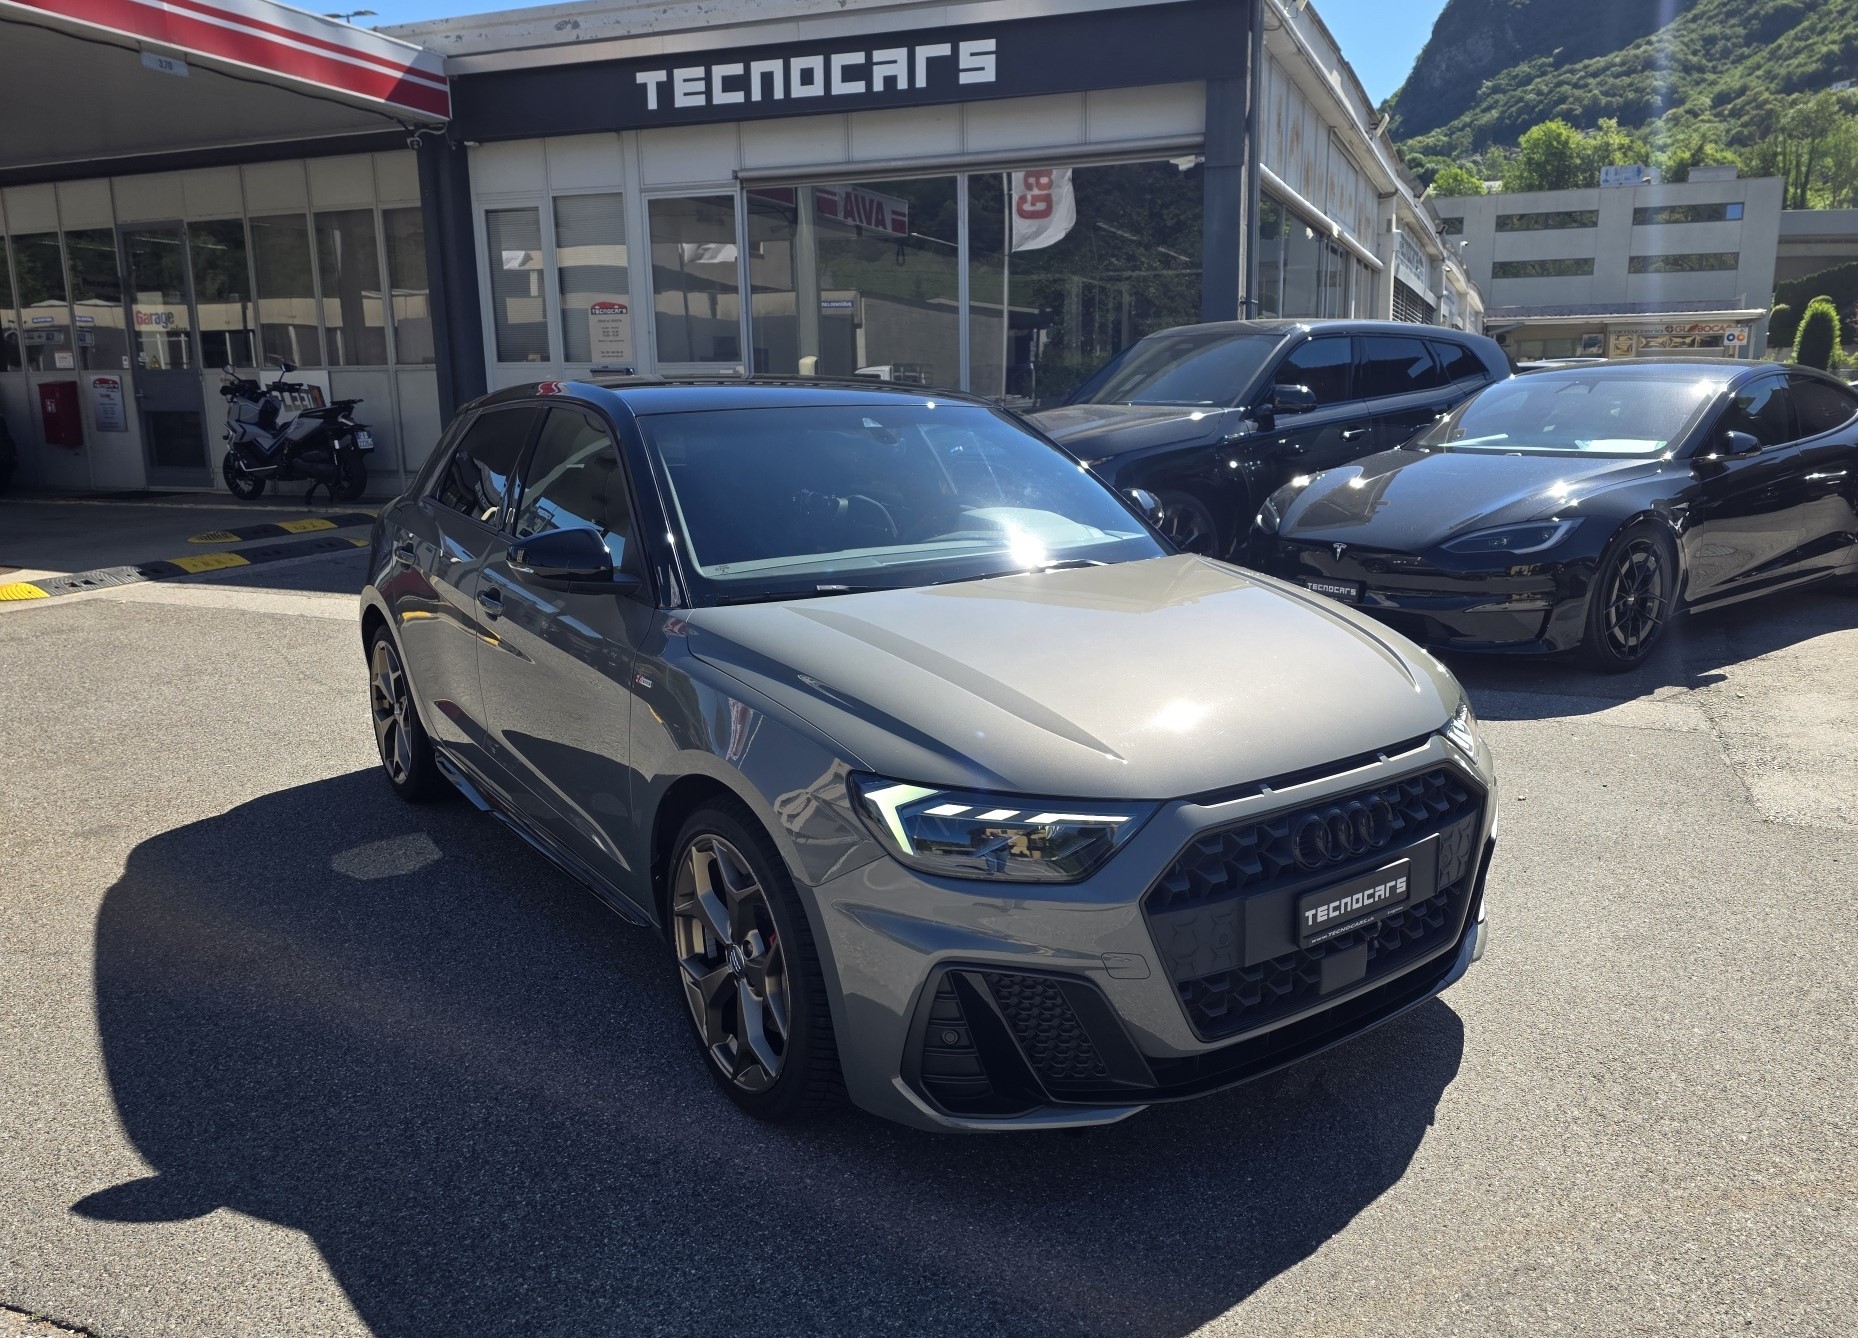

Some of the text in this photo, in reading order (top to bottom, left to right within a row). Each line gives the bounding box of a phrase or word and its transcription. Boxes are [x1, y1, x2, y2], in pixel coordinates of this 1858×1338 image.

[635, 38, 997, 111] TECNOCARS
[135, 310, 175, 329] Garage
[1304, 876, 1407, 926] TECNOCARS
